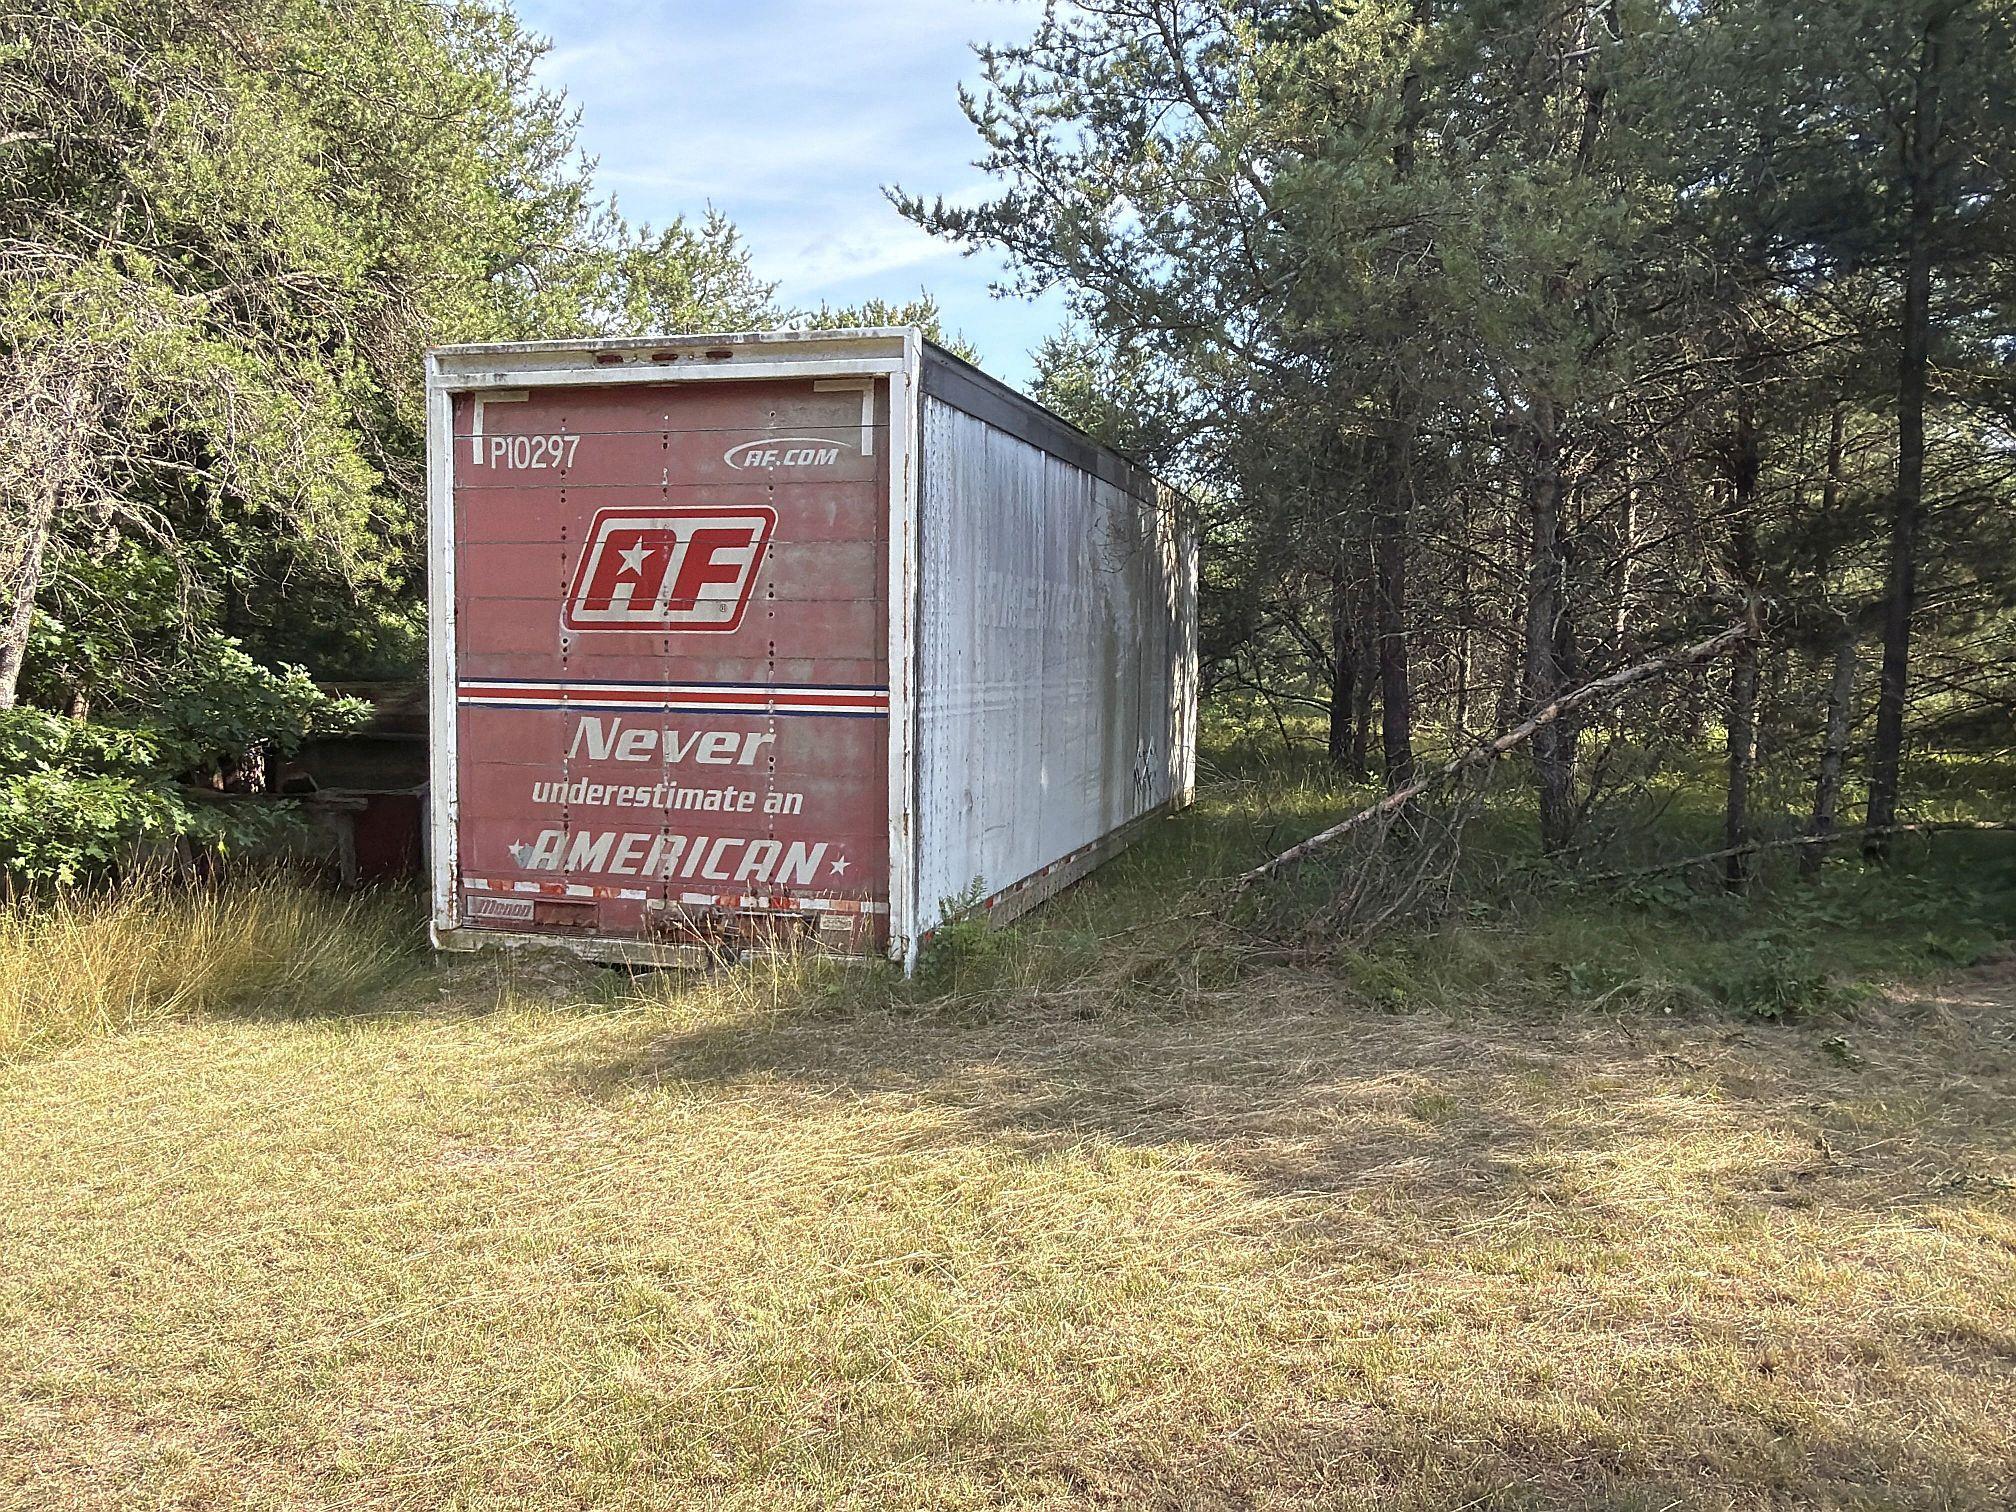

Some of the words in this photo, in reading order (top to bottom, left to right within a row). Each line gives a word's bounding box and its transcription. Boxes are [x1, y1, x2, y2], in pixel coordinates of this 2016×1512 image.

[490, 435, 580, 469] P10297
[744, 448, 839, 468] AF.COM
[583, 528, 755, 612] AF
[568, 716, 777, 766] Never
[531, 776, 754, 813] underestimate
[763, 792, 804, 815] an
[525, 829, 829, 885] AMERICAN
